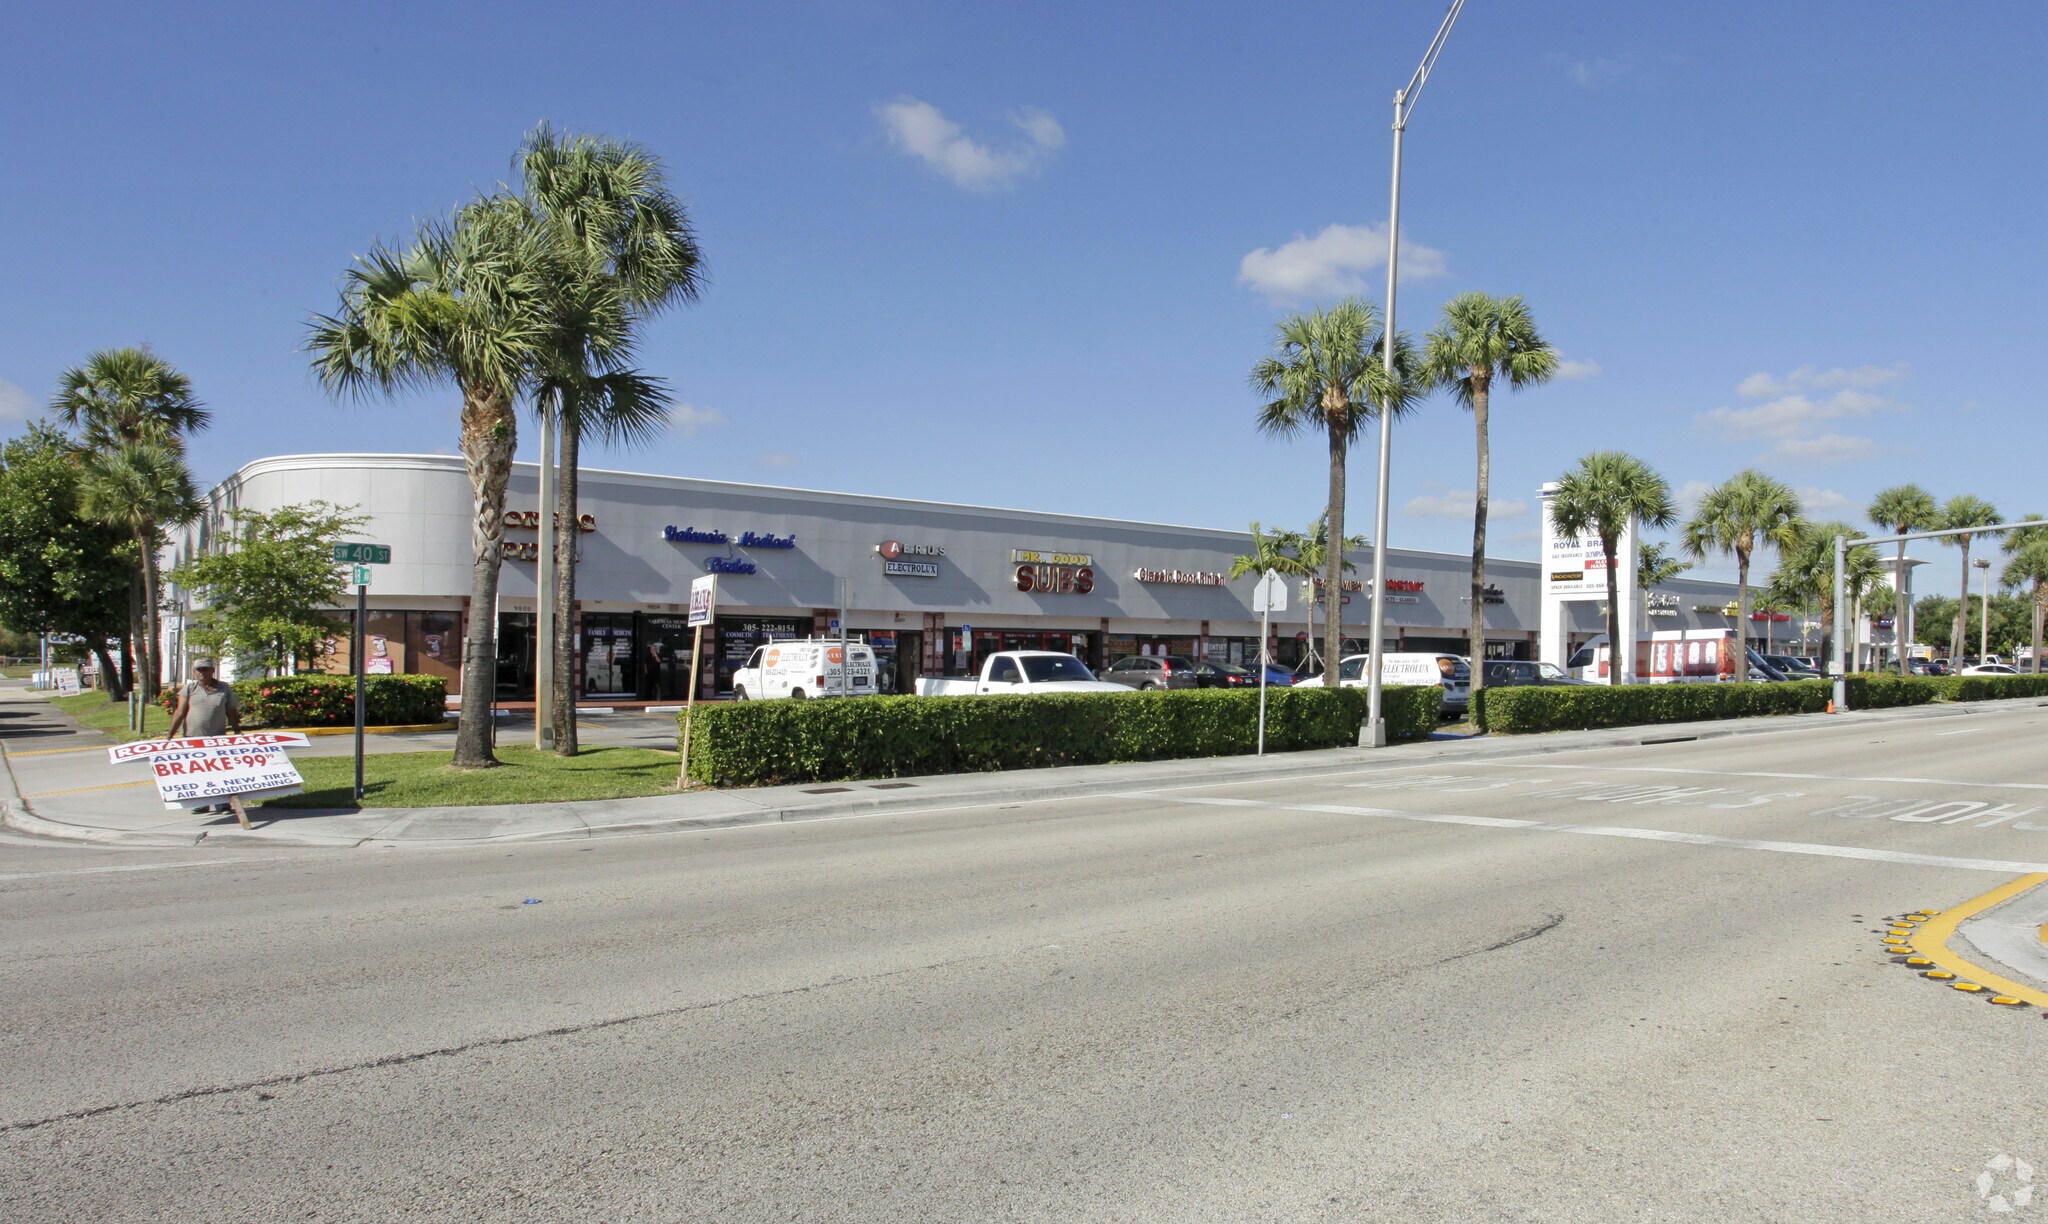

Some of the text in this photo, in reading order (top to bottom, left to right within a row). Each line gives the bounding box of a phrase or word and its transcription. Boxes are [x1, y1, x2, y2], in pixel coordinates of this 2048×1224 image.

[664, 525, 796, 549] Valencia Medical
[1553, 540, 1604, 549] ROYAL BRA
[335, 546, 389, 561] SW 40 ST
[890, 542, 946, 556] AERUS
[709, 558, 756, 575] Center
[1020, 551, 1088, 565] MR. GOOD
[886, 563, 937, 575] ELECTROLUX
[1138, 567, 1174, 583] Classic
[1175, 569, 1197, 584] Door
[1015, 565, 1095, 594] SUBS
[761, 624, 795, 632] 222-9154
[1208, 643, 1227, 651] ENTIST
[1383, 664, 1430, 673] ELECTROLUX
[116, 734, 278, 759] ROYAL BRAKE
[153, 745, 282, 763] AUTO REPAIR
[154, 756, 235, 777] BRAKE
[162, 771, 297, 793] USED & NEW TIRES
[177, 778, 294, 799] AIR CONDITIONING
